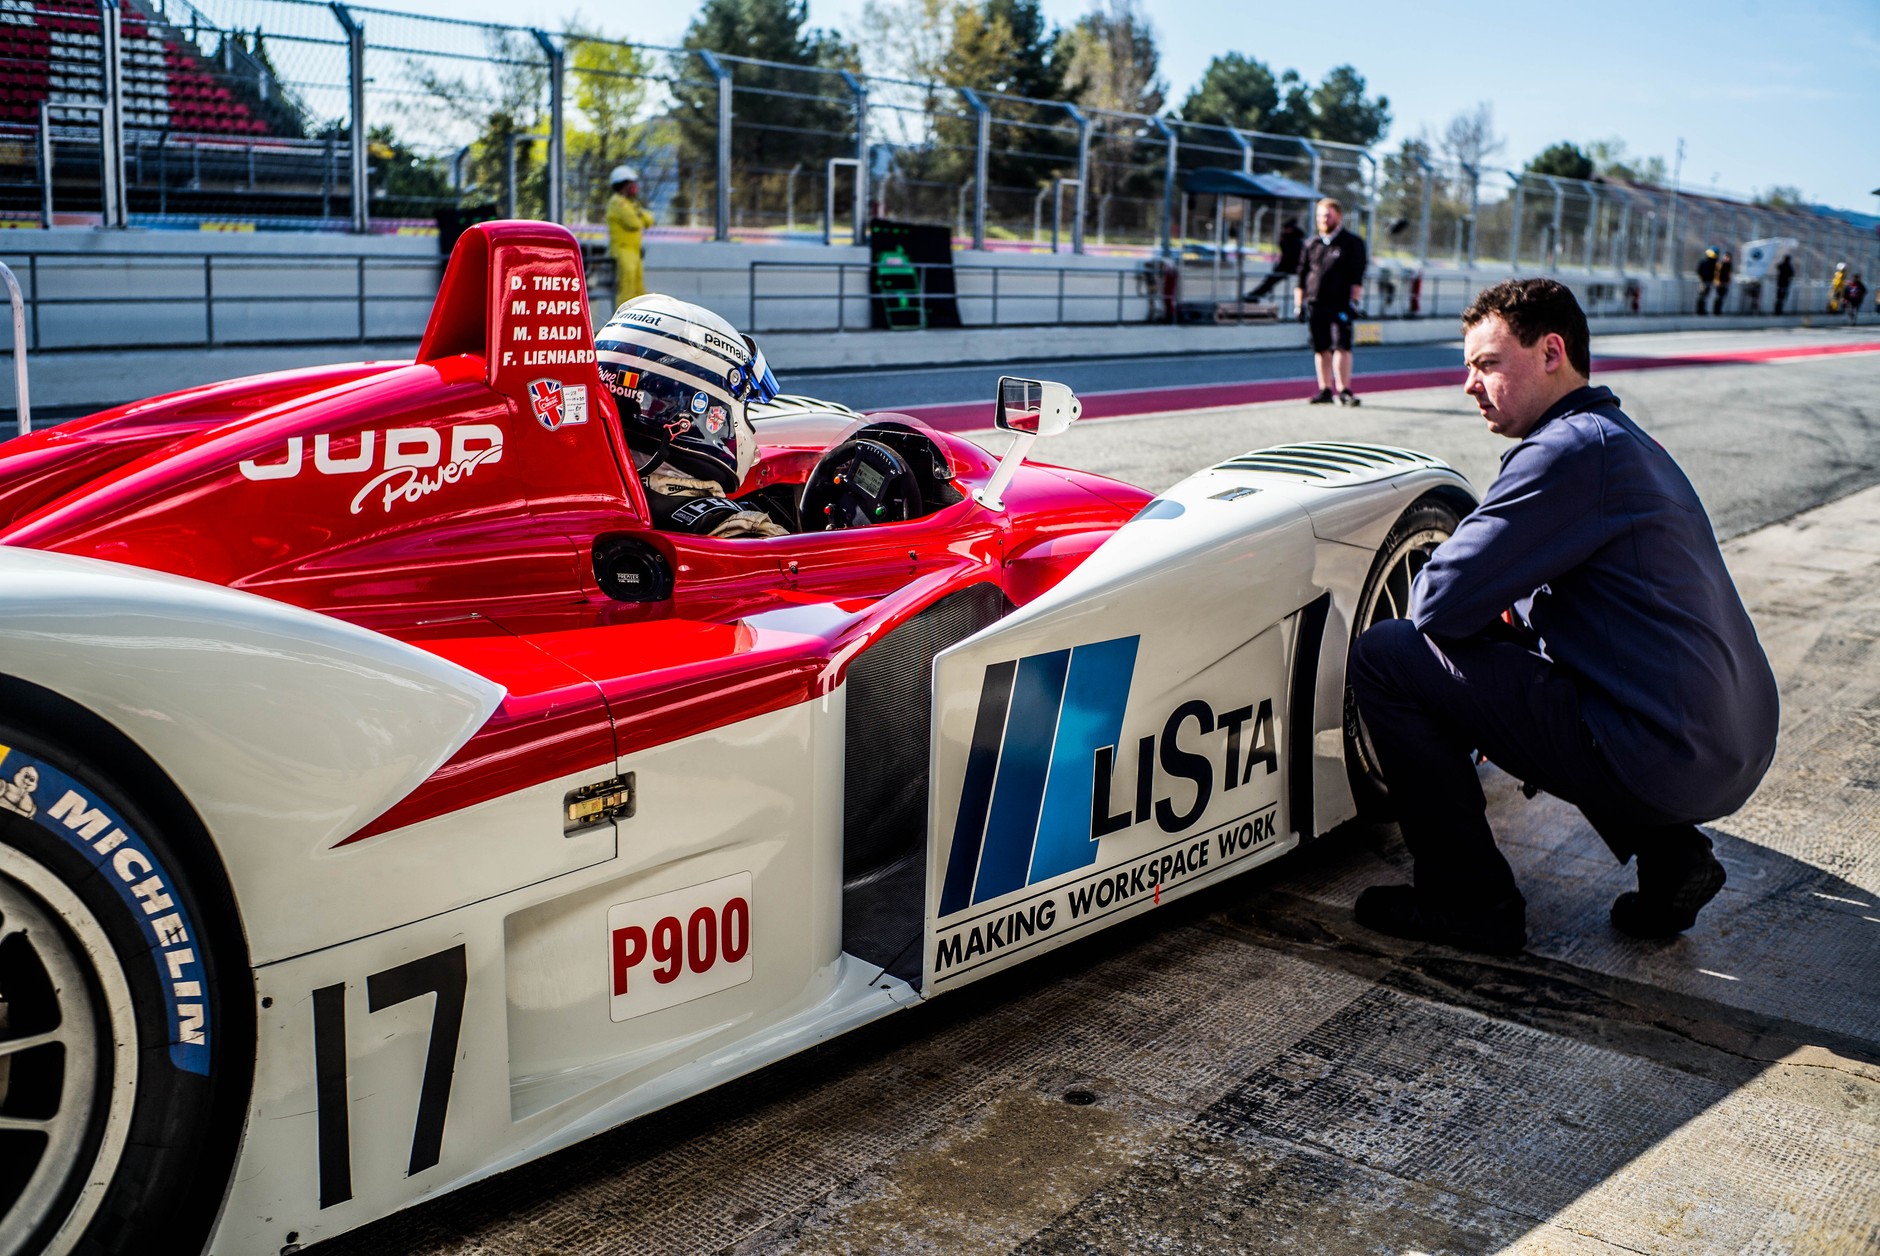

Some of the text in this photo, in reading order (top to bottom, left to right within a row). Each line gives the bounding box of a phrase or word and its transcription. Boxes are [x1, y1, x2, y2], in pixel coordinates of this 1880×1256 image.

[511, 275, 581, 292] D. THEYS
[511, 300, 581, 315] M. PAPIS
[503, 349, 596, 366] F. LIENHARD
[513, 326, 582, 341] M. BALDI
[604, 381, 645, 403] bourg
[239, 424, 504, 481] JUDD
[350, 444, 503, 514] Power
[1089, 698, 1278, 842] LISTA
[47, 789, 205, 1045] MICHELIN
[934, 810, 1276, 973] MAKING WORKSPACE WORK
[612, 897, 750, 997] P900
[312, 943, 468, 1211] 17
